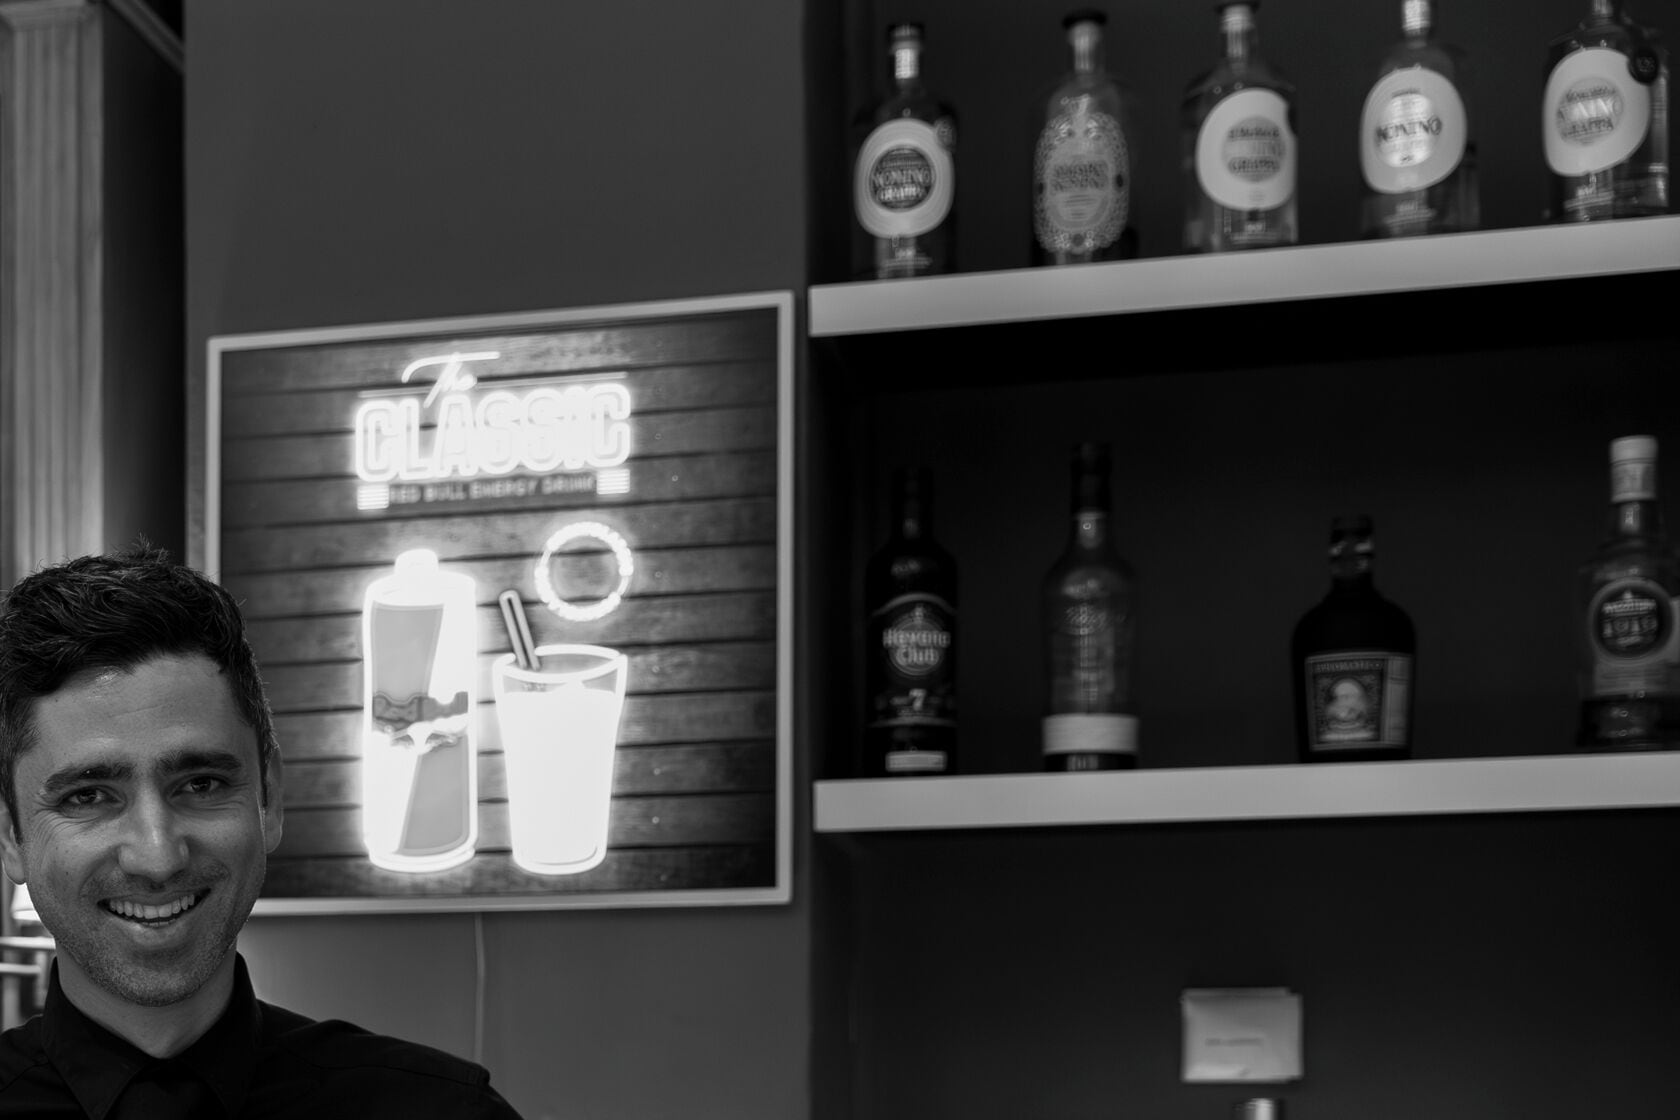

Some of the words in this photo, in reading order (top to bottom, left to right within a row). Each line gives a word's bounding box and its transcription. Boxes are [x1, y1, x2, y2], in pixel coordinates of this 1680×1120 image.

[401, 351, 500, 408] The
[356, 383, 631, 482] CLASSIC
[423, 483, 467, 502] BULL
[469, 478, 541, 500] ENERGY
[541, 473, 595, 495] DRINK
[908, 687, 927, 712] 7
